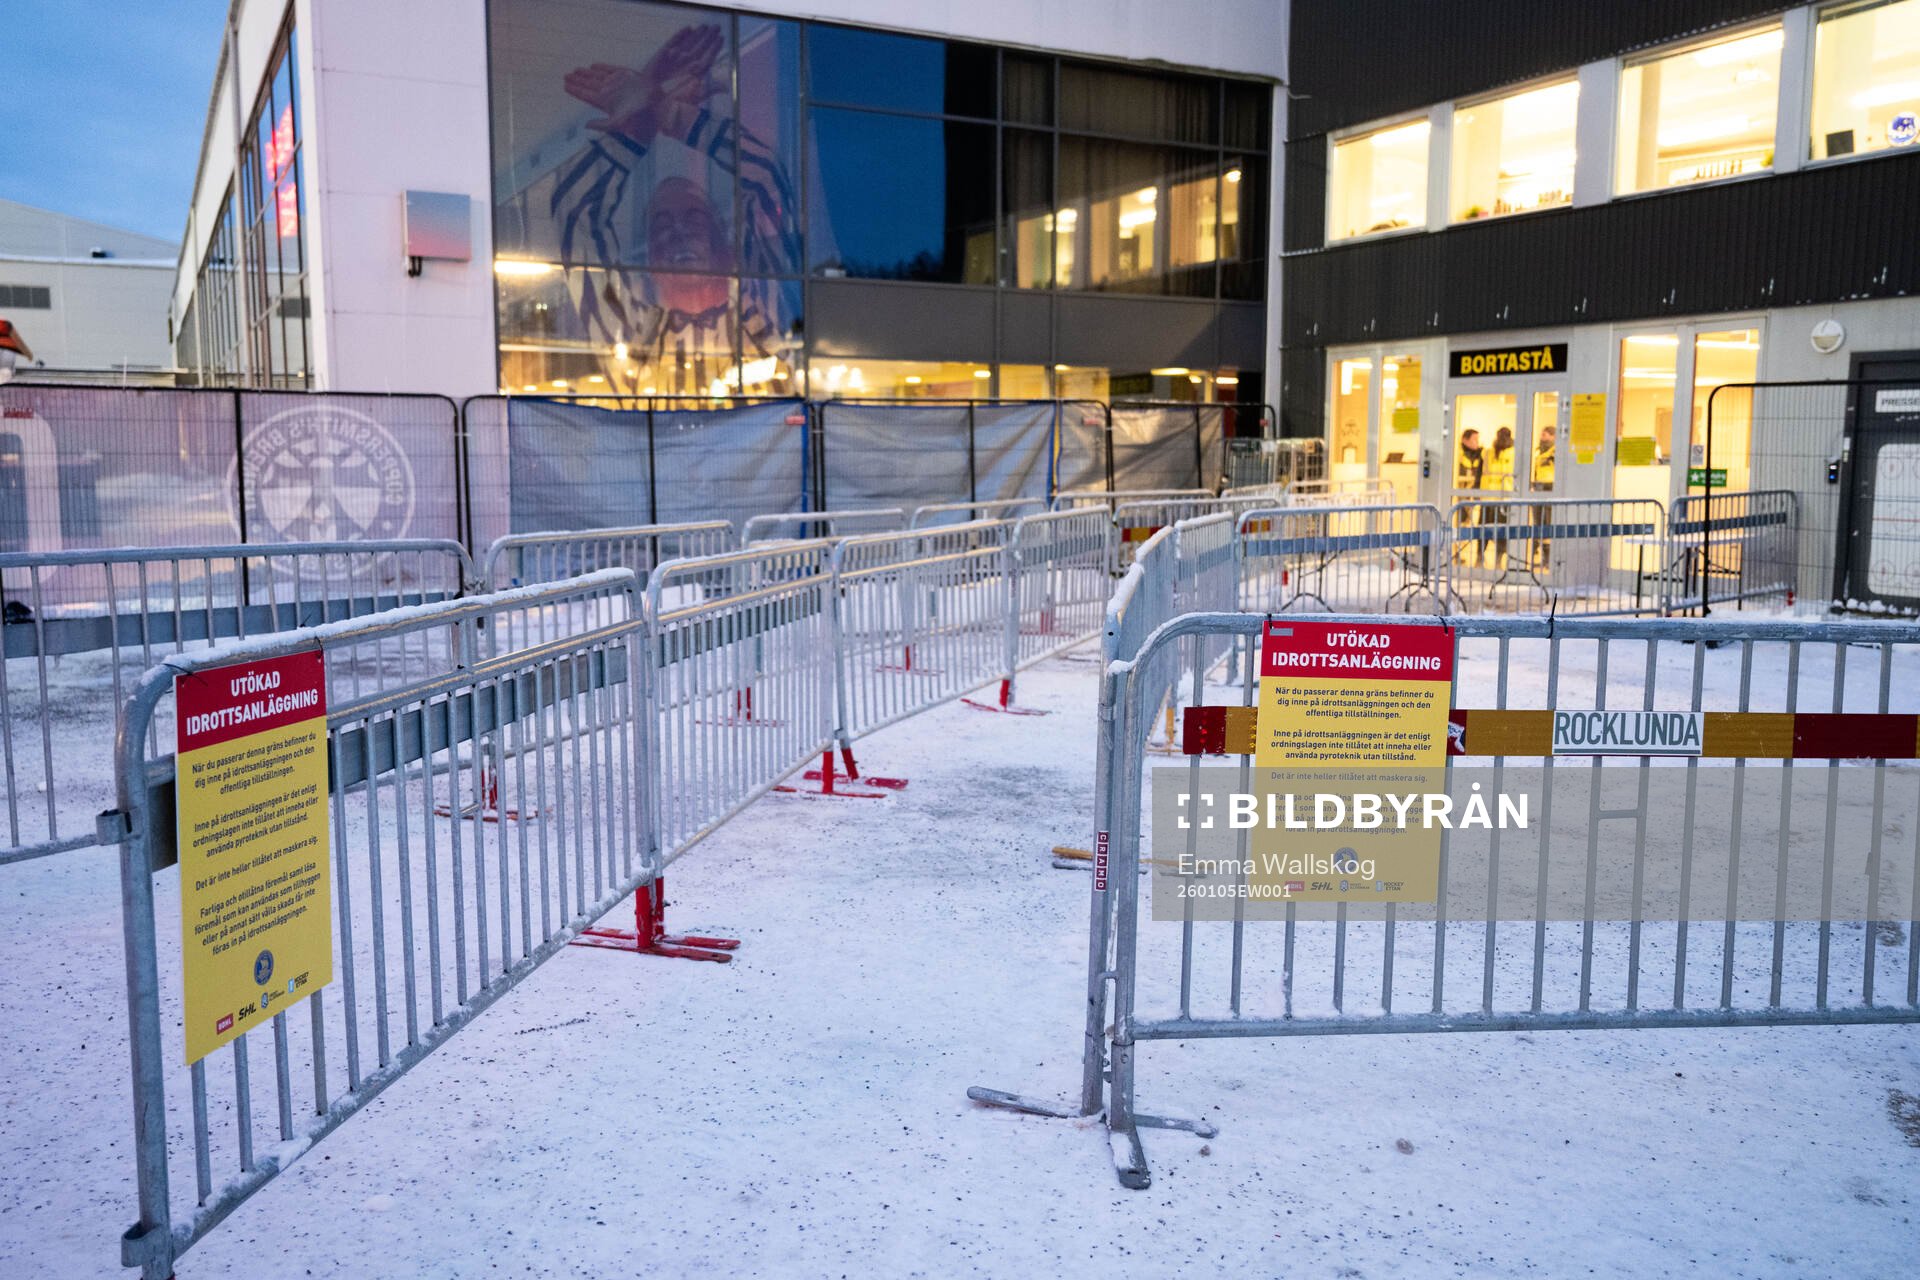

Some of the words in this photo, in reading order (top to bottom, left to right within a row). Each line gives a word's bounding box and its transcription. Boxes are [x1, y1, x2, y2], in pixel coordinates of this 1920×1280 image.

[1461, 346, 1553, 374] BORTASTÅ
[1326, 630, 1390, 648] UTÖKAD
[1272, 652, 1441, 670] IDROTTSANLÄGGNING
[231, 670, 280, 697] UTÖKAD
[1275, 687, 1289, 695] När
[1340, 689, 1363, 697] denna
[1365, 689, 1388, 698] gräns
[1389, 690, 1422, 698] befinner
[186, 688, 318, 736] IDROTTSANLÄGGNING
[1277, 698, 1289, 707] dig
[1291, 698, 1308, 706] inne
[1310, 699, 1319, 708] på
[1321, 699, 1399, 709] idrottsanläggningen
[1416, 701, 1430, 709] den
[1305, 709, 1342, 719] offentliga
[1345, 710, 1401, 720] tillställningen.
[1273, 729, 1290, 737] Inne
[1292, 730, 1302, 739] på
[1304, 730, 1381, 740] idrottsanläggningen
[1408, 733, 1430, 741] enligt
[1554, 712, 1700, 746] ROCKLUNDA
[216, 753, 245, 770] passerar
[246, 748, 265, 760] denna
[266, 742, 283, 756] gräns
[284, 736, 307, 749] befinner
[1270, 740, 1326, 750] ordningslagen
[1328, 741, 1343, 749] inte
[1385, 742, 1411, 750] inneha
[1319, 752, 1360, 760] pyroteknik
[206, 774, 221, 785] inne
[219, 779, 250, 795] offentliga
[1296, 772, 1311, 780] inte
[1414, 774, 1427, 783] sig.
[194, 821, 209, 833] Inne
[301, 783, 316, 796] enligt
[241, 820, 253, 831] inte
[255, 811, 275, 826] tillåtet
[285, 801, 304, 815] inneha
[305, 797, 318, 808] eller
[206, 839, 233, 857] använda
[235, 826, 267, 849] pyroteknik
[269, 823, 282, 834] utan
[283, 812, 308, 829] tillstånd.
[218, 871, 230, 882] inte
[231, 863, 250, 877] heller
[252, 853, 272, 869] tillåtet
[282, 840, 307, 856] maskera
[308, 835, 317, 846] sig.
[1097, 833, 1108, 889] CRAMO
[200, 901, 224, 919] Farliga
[238, 884, 263, 902] otillåtna
[265, 872, 288, 890] föremål
[289, 866, 303, 880] samt
[304, 862, 315, 873] lösa
[1310, 881, 1334, 891] SHL
[194, 915, 221, 936] föremål
[250, 892, 278, 911] användas
[293, 873, 320, 892] tillhyggen
[202, 932, 218, 947] eller
[229, 918, 247, 934] annat
[248, 912, 260, 925] sätt
[261, 905, 276, 919] vålla
[277, 897, 294, 912] skada
[304, 888, 315, 899] inte
[212, 941, 229, 956] föras
[238, 1002, 257, 1022] SHL
